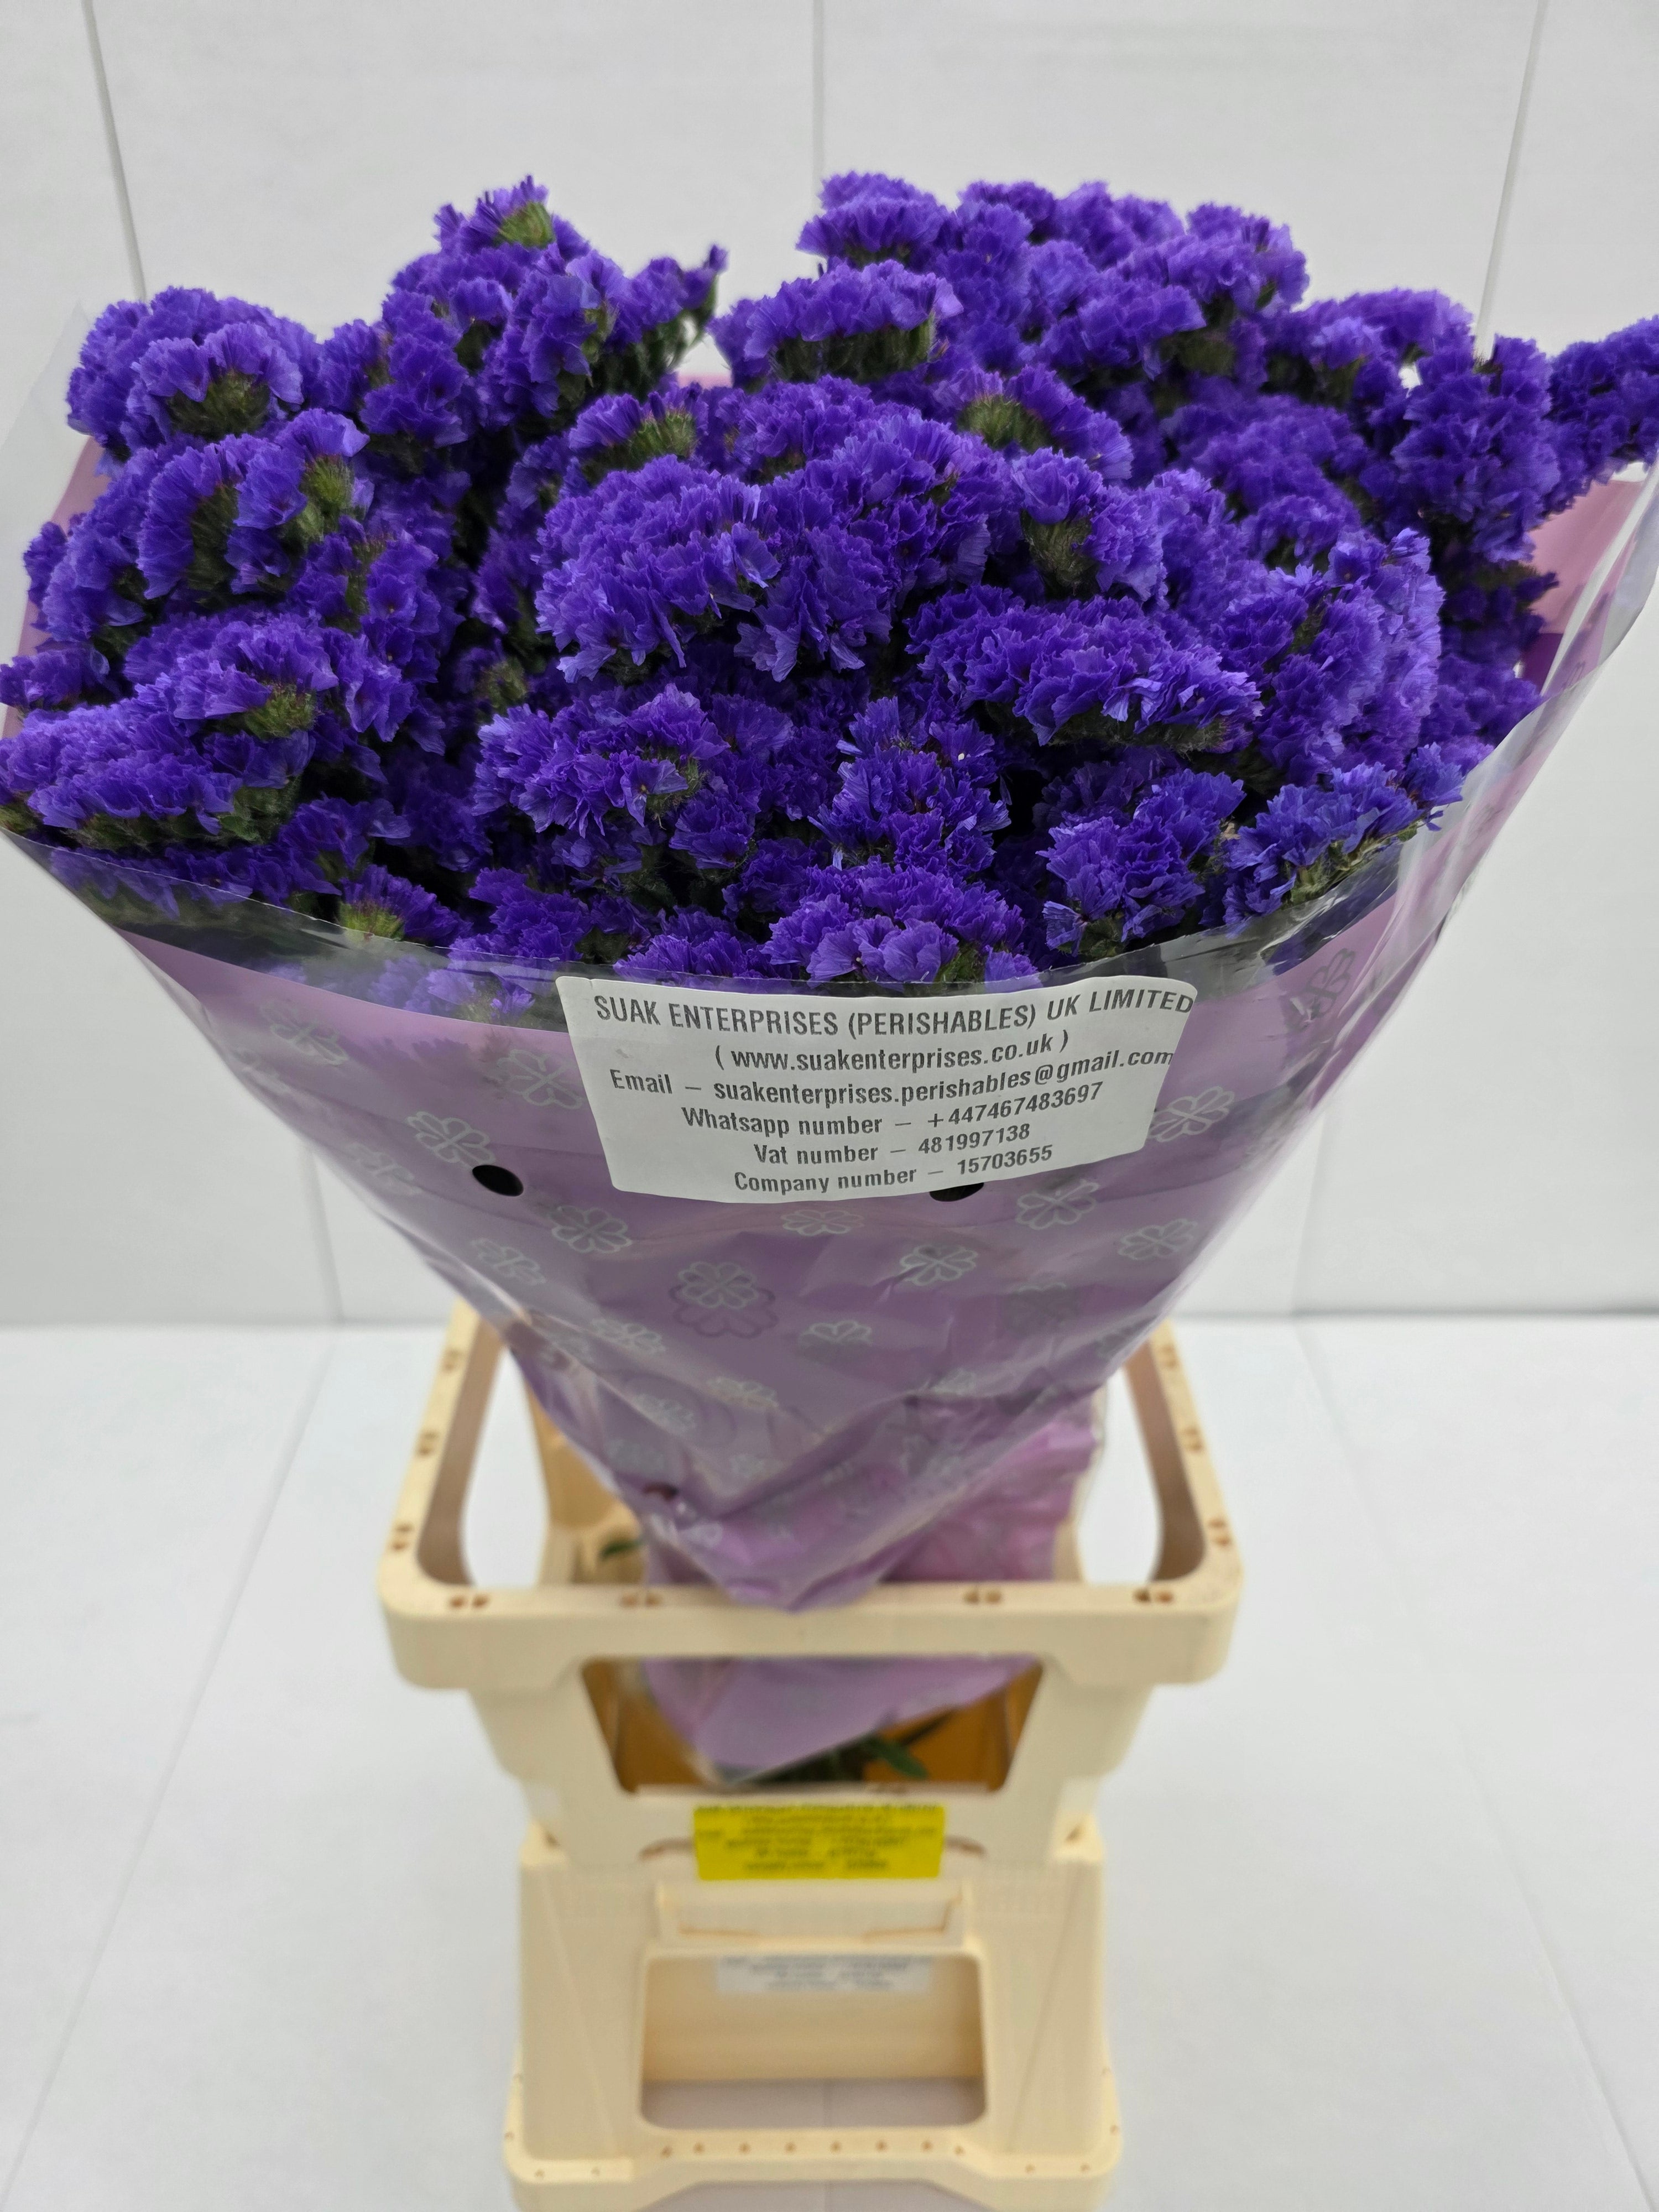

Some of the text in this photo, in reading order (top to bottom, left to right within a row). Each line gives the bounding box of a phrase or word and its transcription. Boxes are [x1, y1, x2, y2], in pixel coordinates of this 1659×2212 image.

[594, 988, 1194, 1040] SUAK ENTERPRISES (PERISHABLES) UK LIMITED
[731, 1034, 1053, 1073] www.suakenterprises.co.uk
[609, 1069, 672, 1094] Email
[713, 1050, 1173, 1109] suakenterprises.perishables@gmail.com
[681, 1107, 789, 1138] Whatsapp
[799, 1115, 882, 1135] number
[927, 1081, 1103, 1128] +447467483697
[734, 1172, 829, 1195] Company
[837, 1167, 917, 1189] number
[957, 1144, 1053, 1175] 15703655
[754, 1144, 787, 1165] Vat
[796, 1145, 878, 1165] number
[918, 1123, 1030, 1155] 481997138
